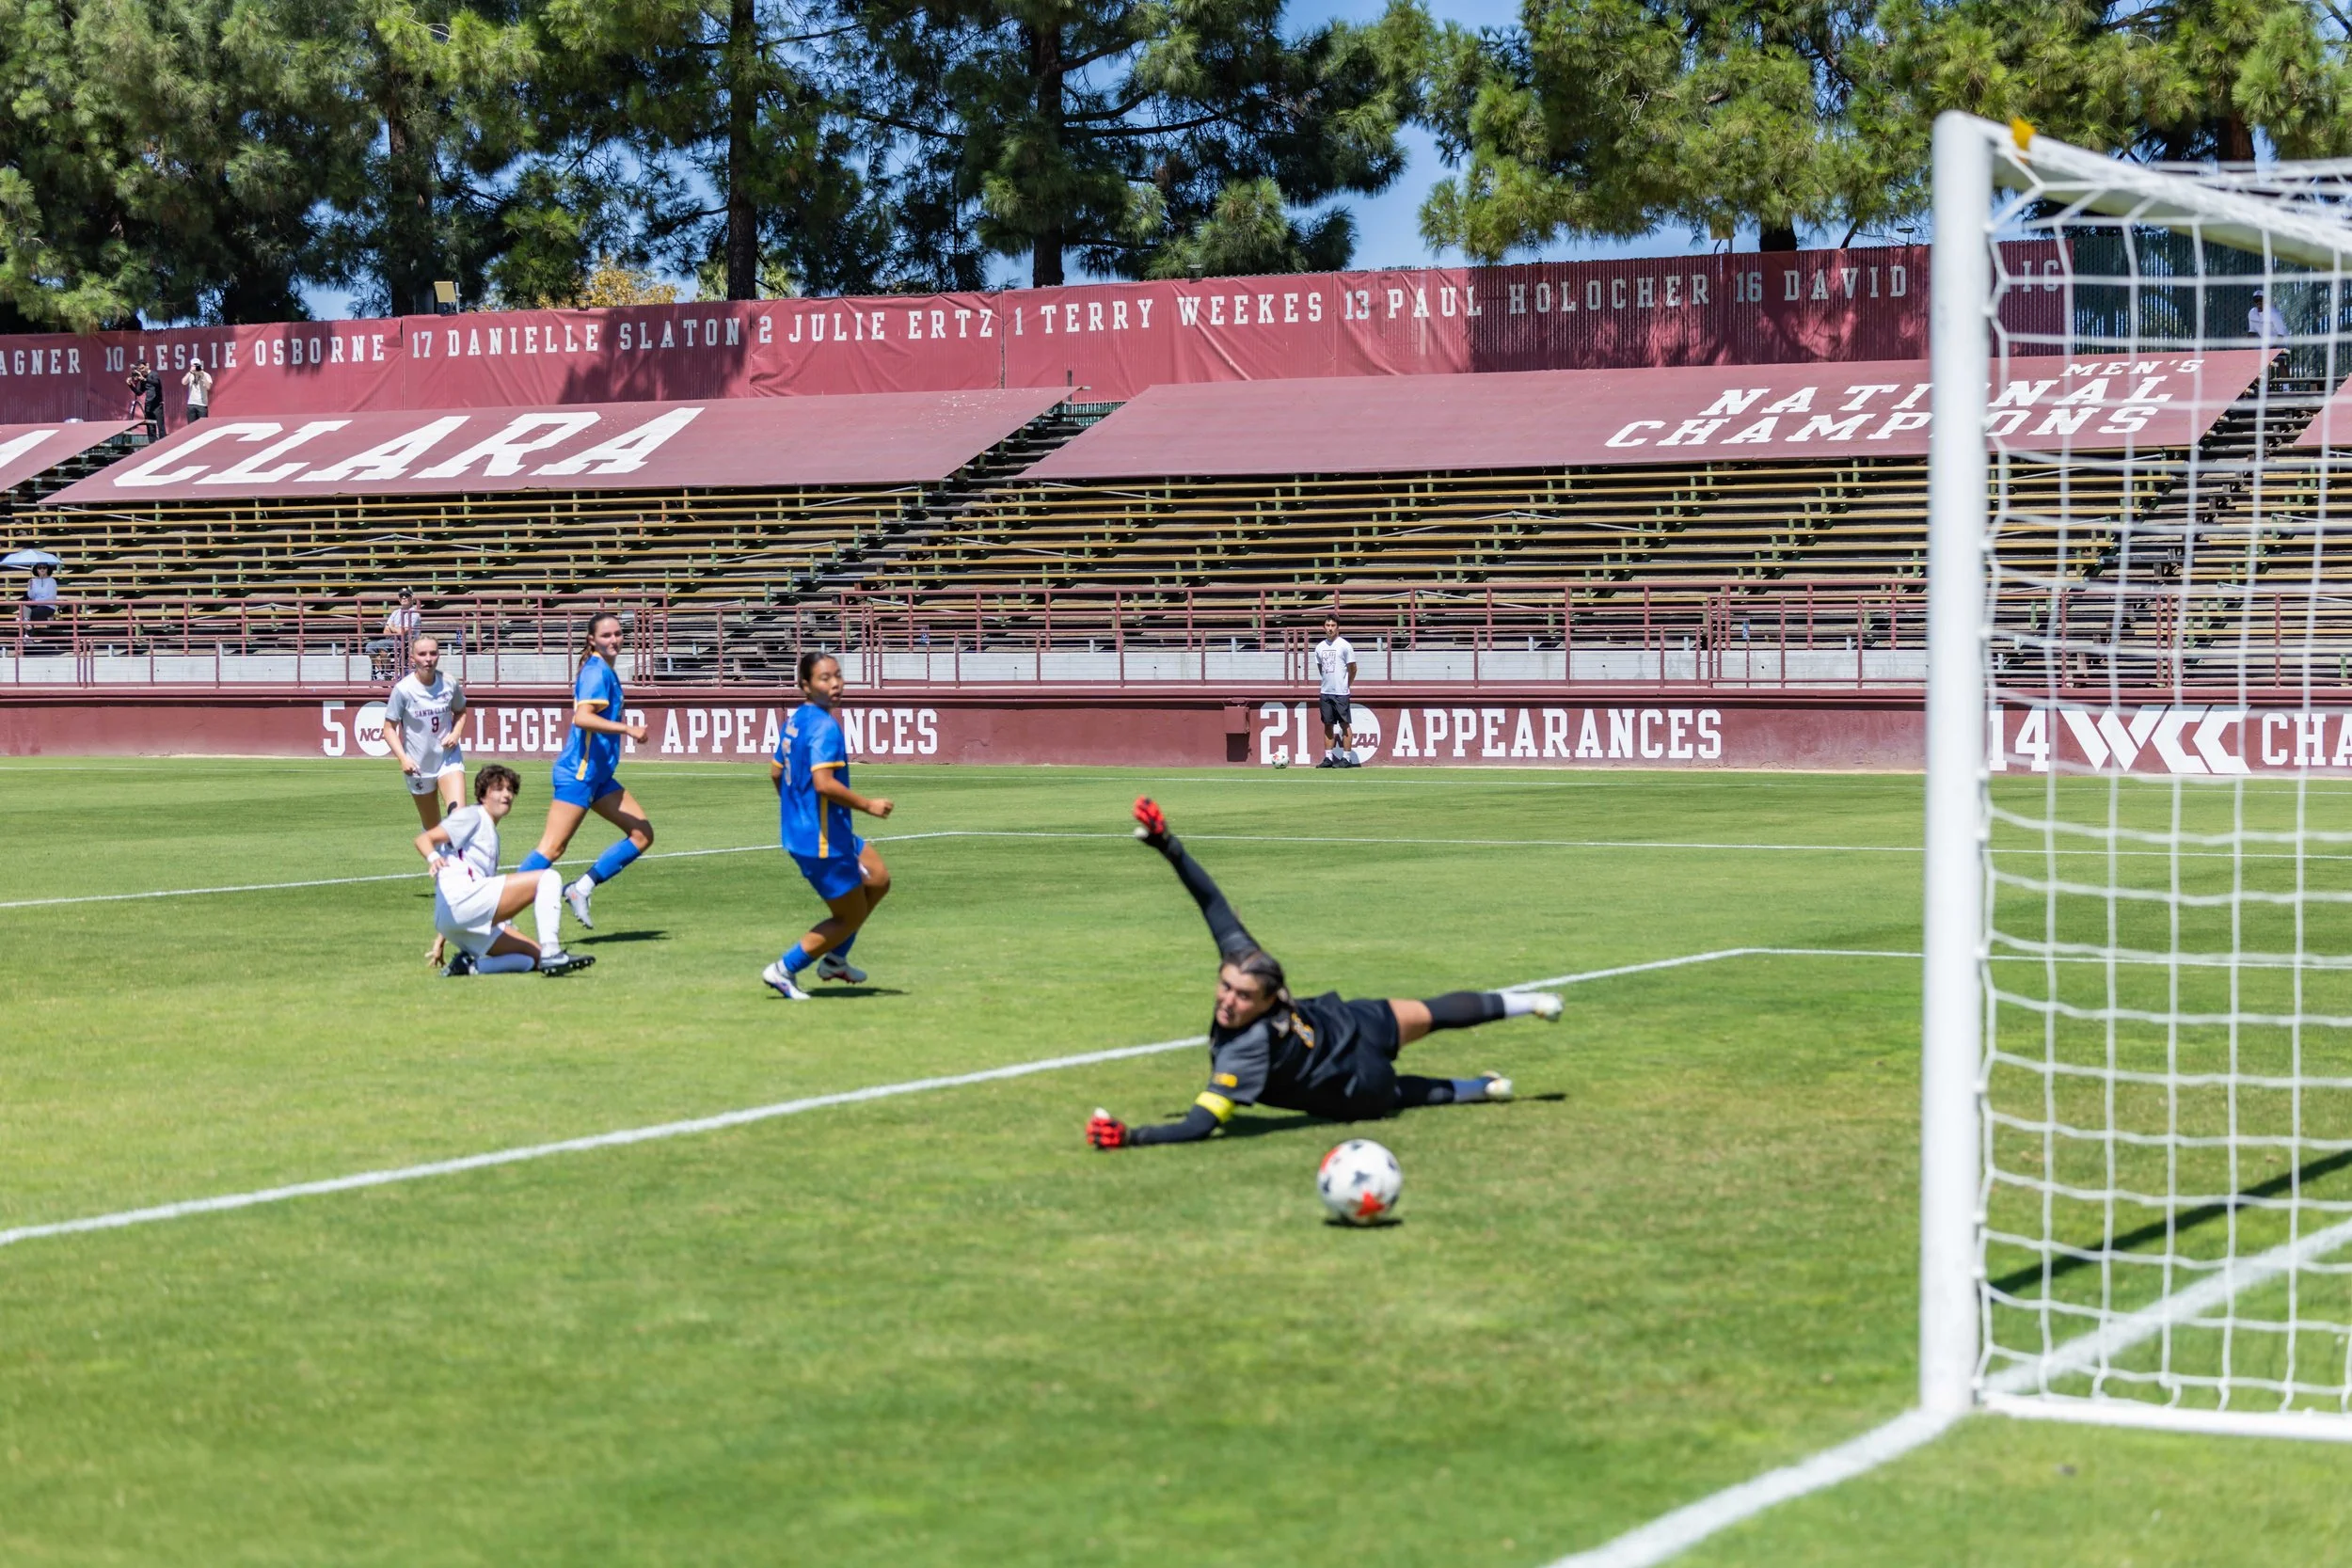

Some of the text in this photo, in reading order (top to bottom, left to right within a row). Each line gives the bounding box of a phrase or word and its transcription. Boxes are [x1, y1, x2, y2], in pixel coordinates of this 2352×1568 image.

[1345, 274, 1709, 320] 13 PAUL HOLOCHER
[1736, 265, 1907, 303] 16 DAVID
[758, 309, 993, 344] 2 JULIE ERTZ
[1015, 292, 1322, 336] 1 TERRY WEEKES
[105, 346, 124, 372] 10
[254, 334, 385, 366] OSBORNE
[412, 317, 740, 358] 17 DANIELLE SLATON
[2059, 359, 2204, 376] MEN'S
[1698, 376, 2173, 415] NATINAL
[114, 406, 706, 486] CLARA
[1604, 407, 2158, 447] CHAMPONS
[323, 700, 345, 756] 5
[660, 708, 938, 754] APPEANCES
[431, 716, 439, 733] 9
[1261, 702, 1311, 765] 21
[1392, 708, 1723, 758] APPEARANCES
[1988, 704, 2050, 771] 14
[2058, 705, 2251, 774] WCC
